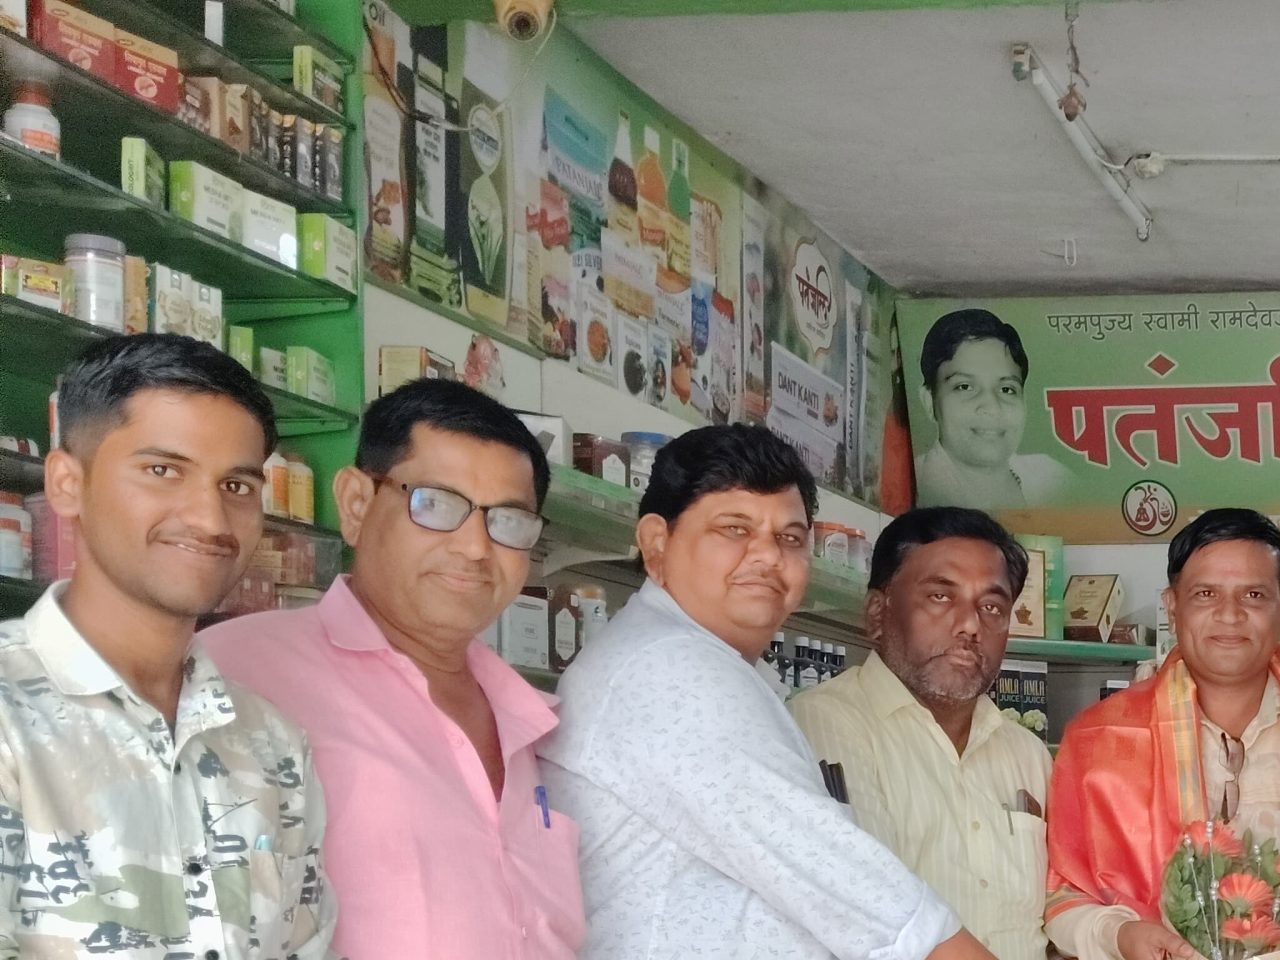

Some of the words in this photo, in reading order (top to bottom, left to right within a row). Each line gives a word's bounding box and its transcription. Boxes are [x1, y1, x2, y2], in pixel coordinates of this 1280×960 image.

[1047, 313, 1133, 340] परमपुज्य
[1142, 303, 1200, 331] स्वामी
[777, 371, 797, 398] DANT
[797, 384, 819, 410] KANTI
[1000, 677, 1020, 695] AMLA
[1023, 679, 1045, 697] AMLA
[1000, 694, 1021, 703] JUICE
[1023, 696, 1047, 705] JUICE
